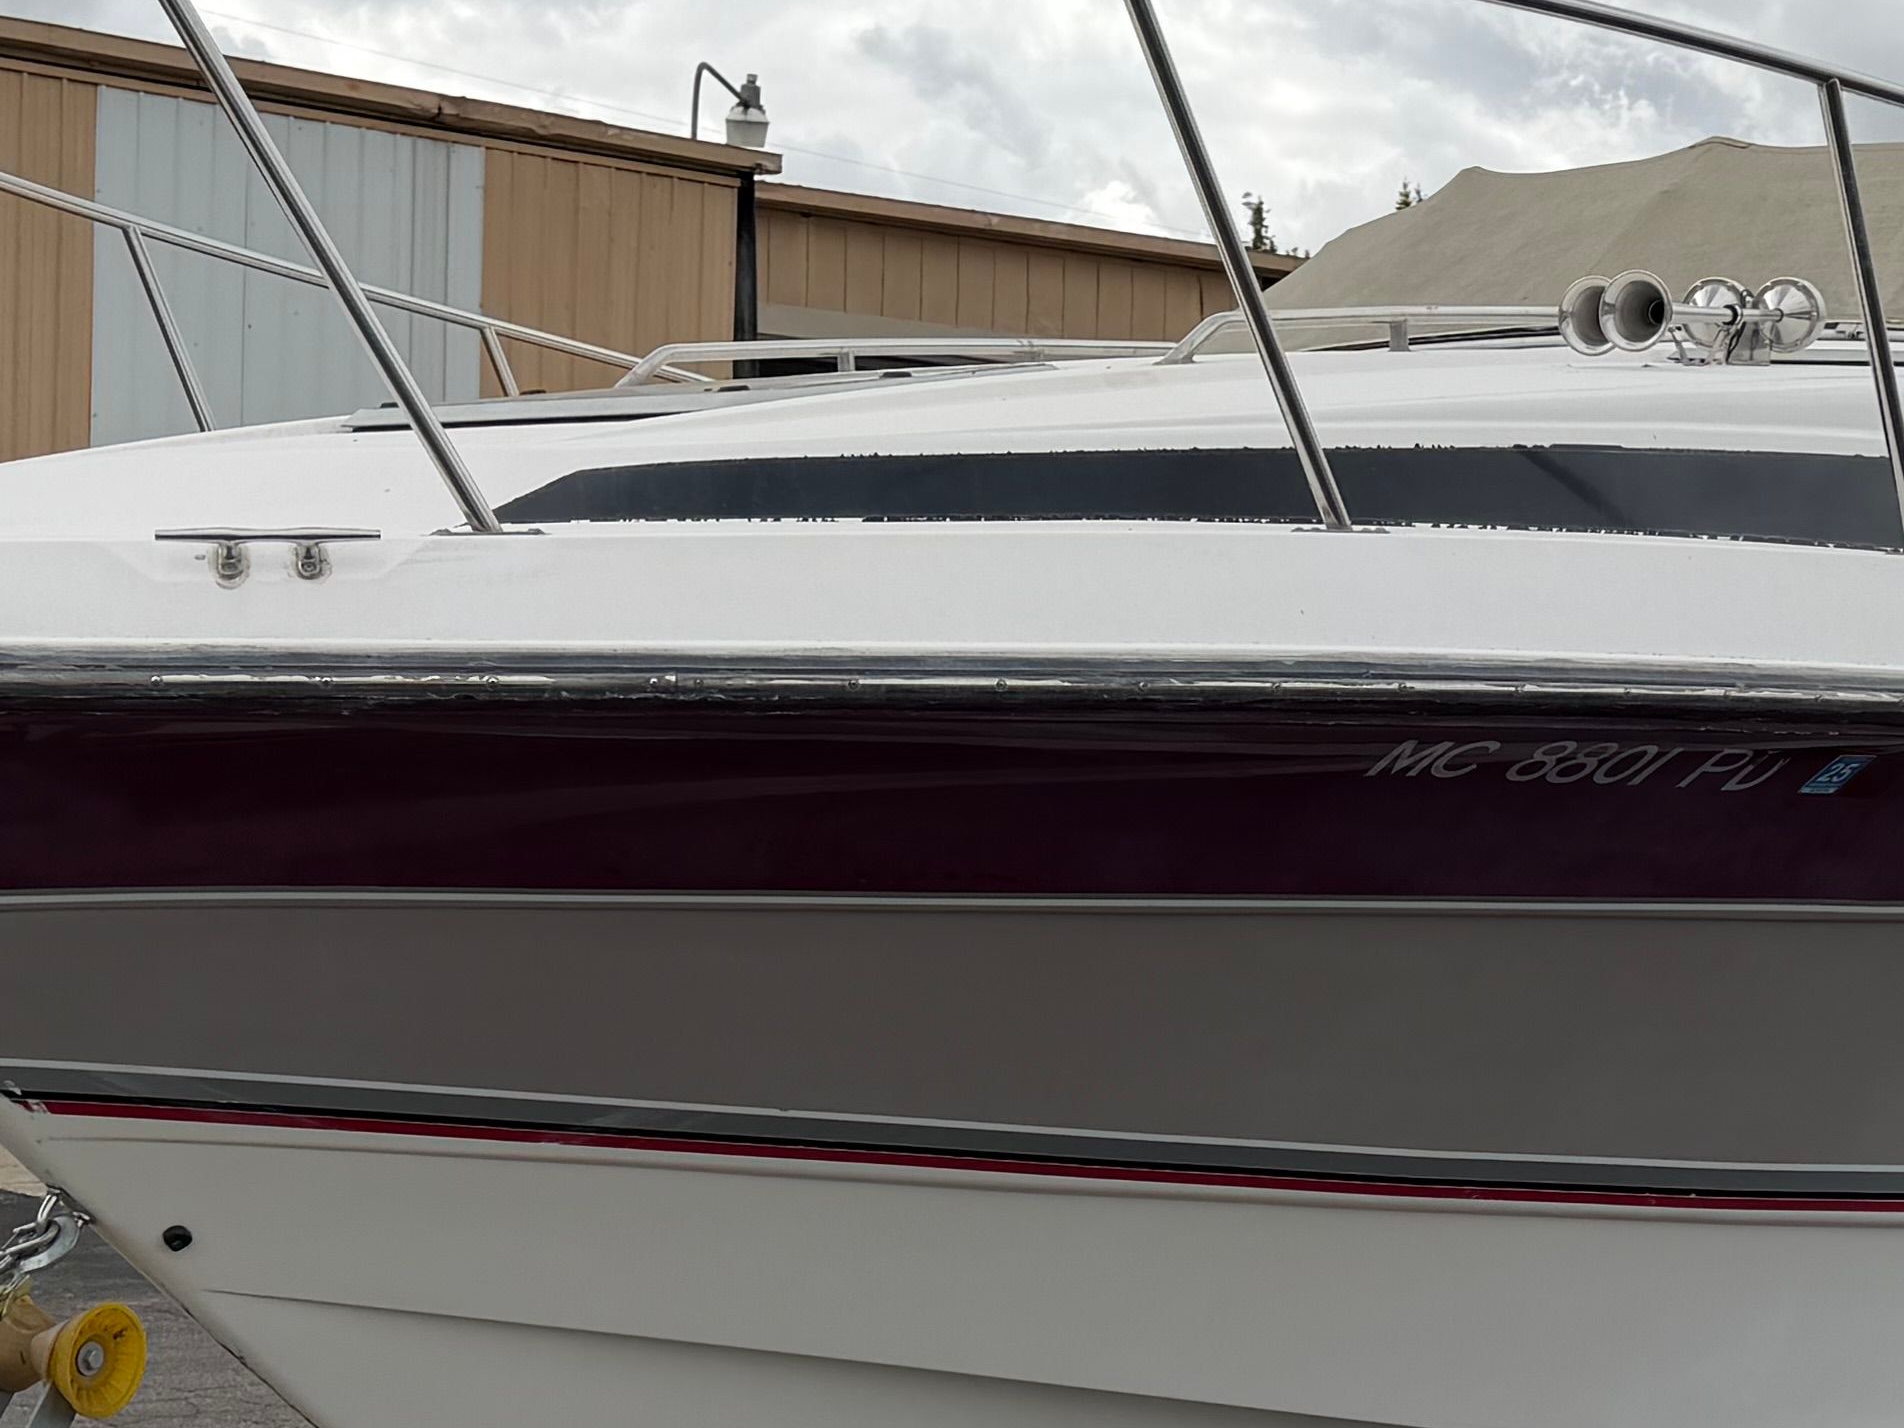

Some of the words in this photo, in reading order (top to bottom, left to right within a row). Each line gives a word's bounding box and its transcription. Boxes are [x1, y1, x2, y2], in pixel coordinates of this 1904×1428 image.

[1366, 739, 1501, 778] MC
[1506, 740, 1672, 787] 8801
[1819, 762, 1860, 783] 25
